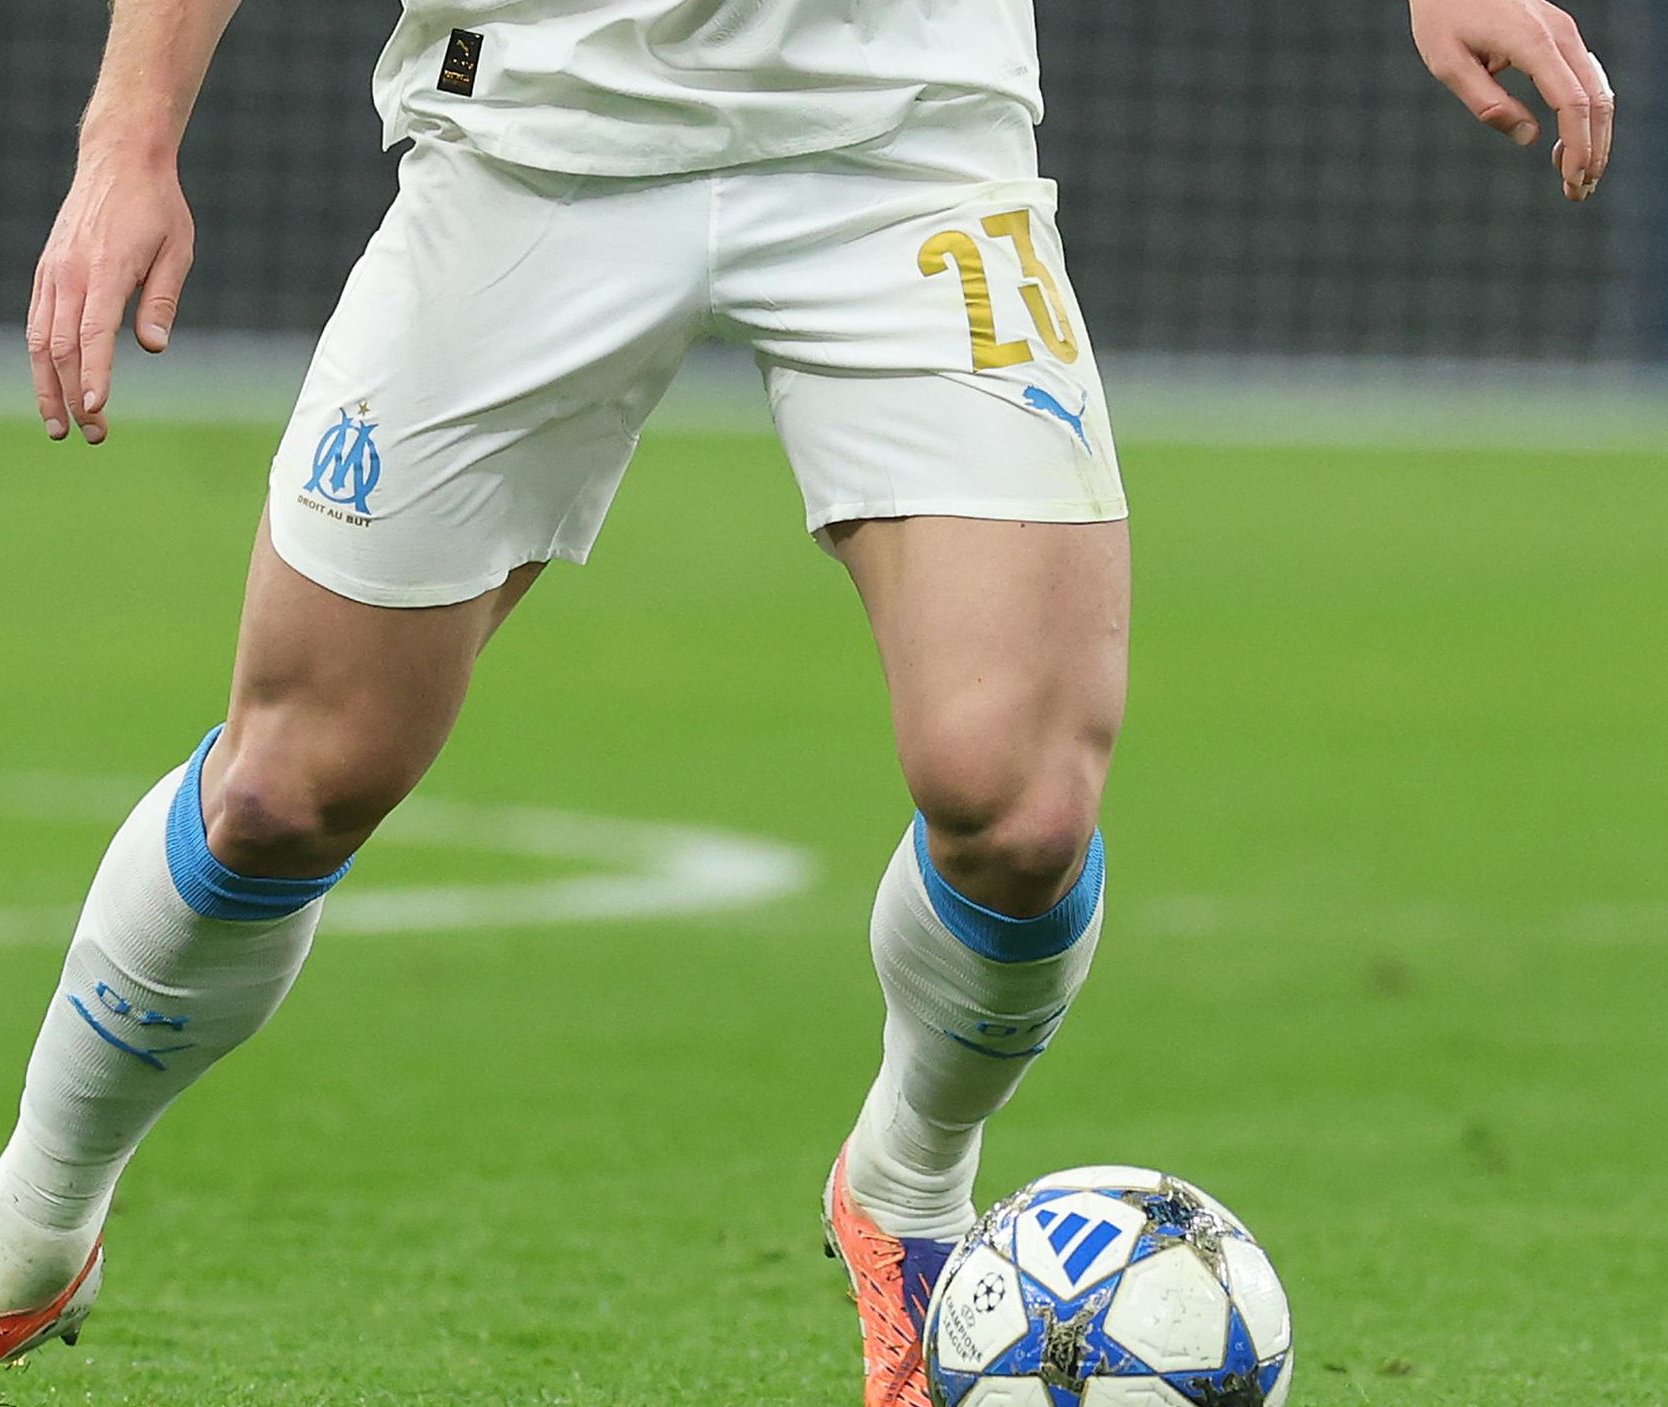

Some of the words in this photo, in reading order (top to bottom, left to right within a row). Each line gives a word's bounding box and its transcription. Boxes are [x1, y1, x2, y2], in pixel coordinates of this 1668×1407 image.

[917, 208, 1080, 375] 23
[297, 495, 326, 513] DROIT
[327, 509, 343, 520] AU
[346, 514, 372, 528] BUT
